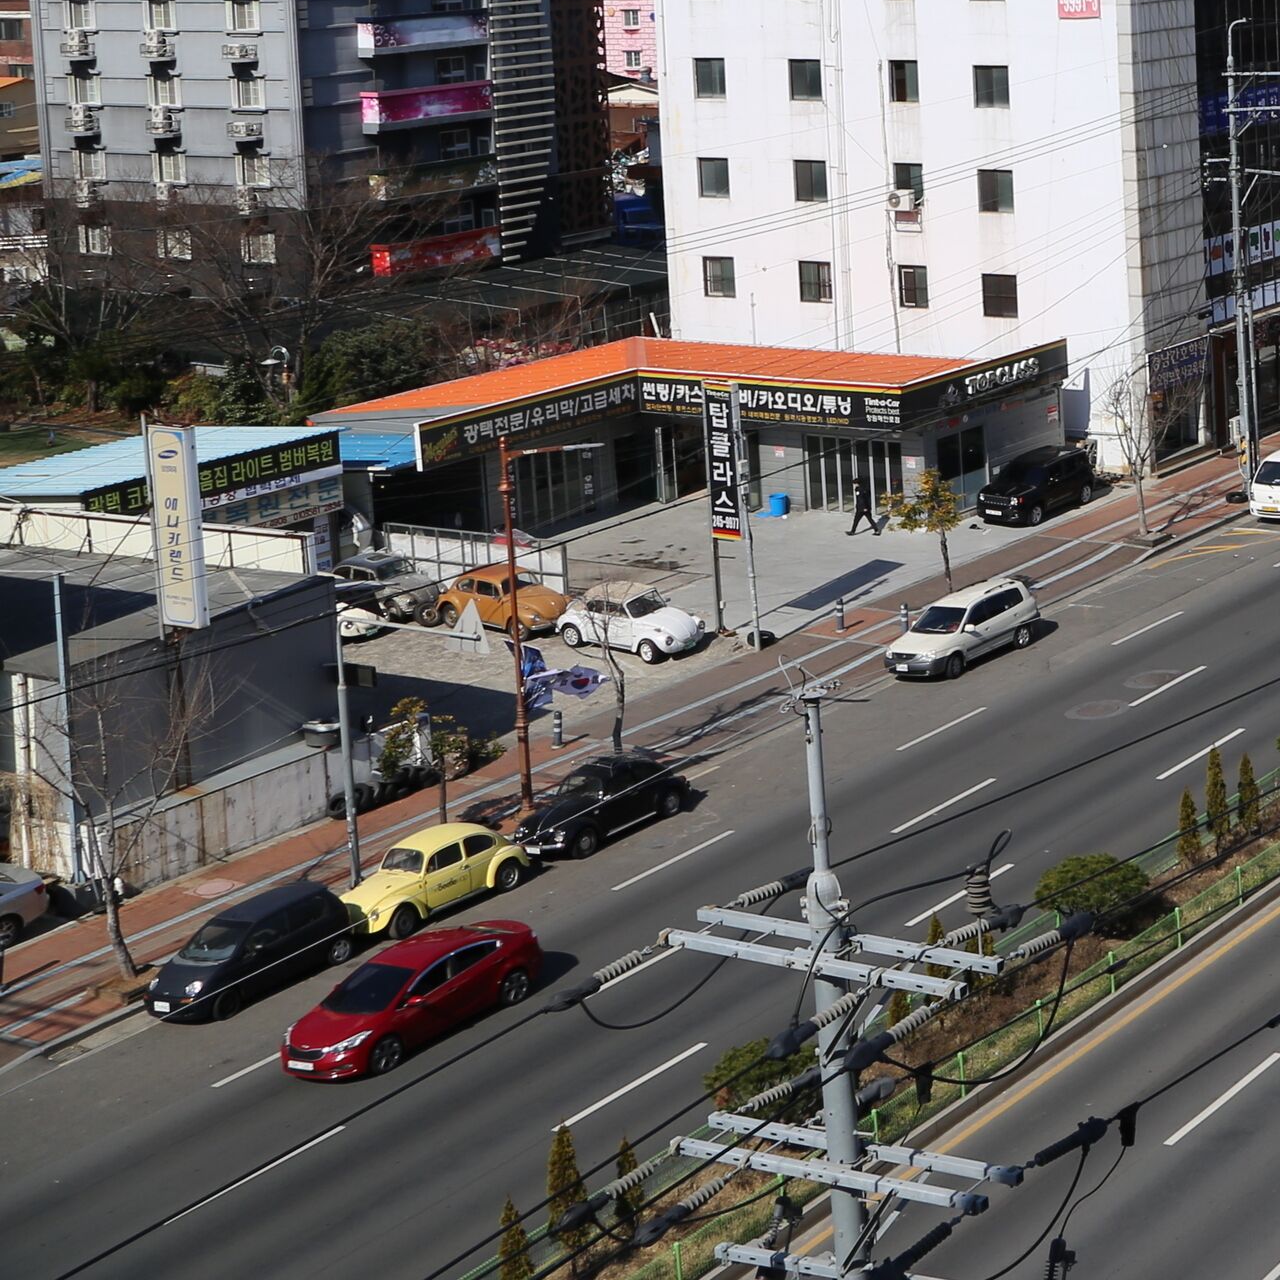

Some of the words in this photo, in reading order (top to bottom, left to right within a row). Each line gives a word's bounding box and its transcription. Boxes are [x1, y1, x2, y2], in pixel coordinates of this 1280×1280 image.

[463, 383, 637, 445] 광택전문/유리막/고급세차
[709, 403, 736, 513] 탑클라스
[89, 493, 121, 515] 광택
[200, 470, 228, 492] 흠집
